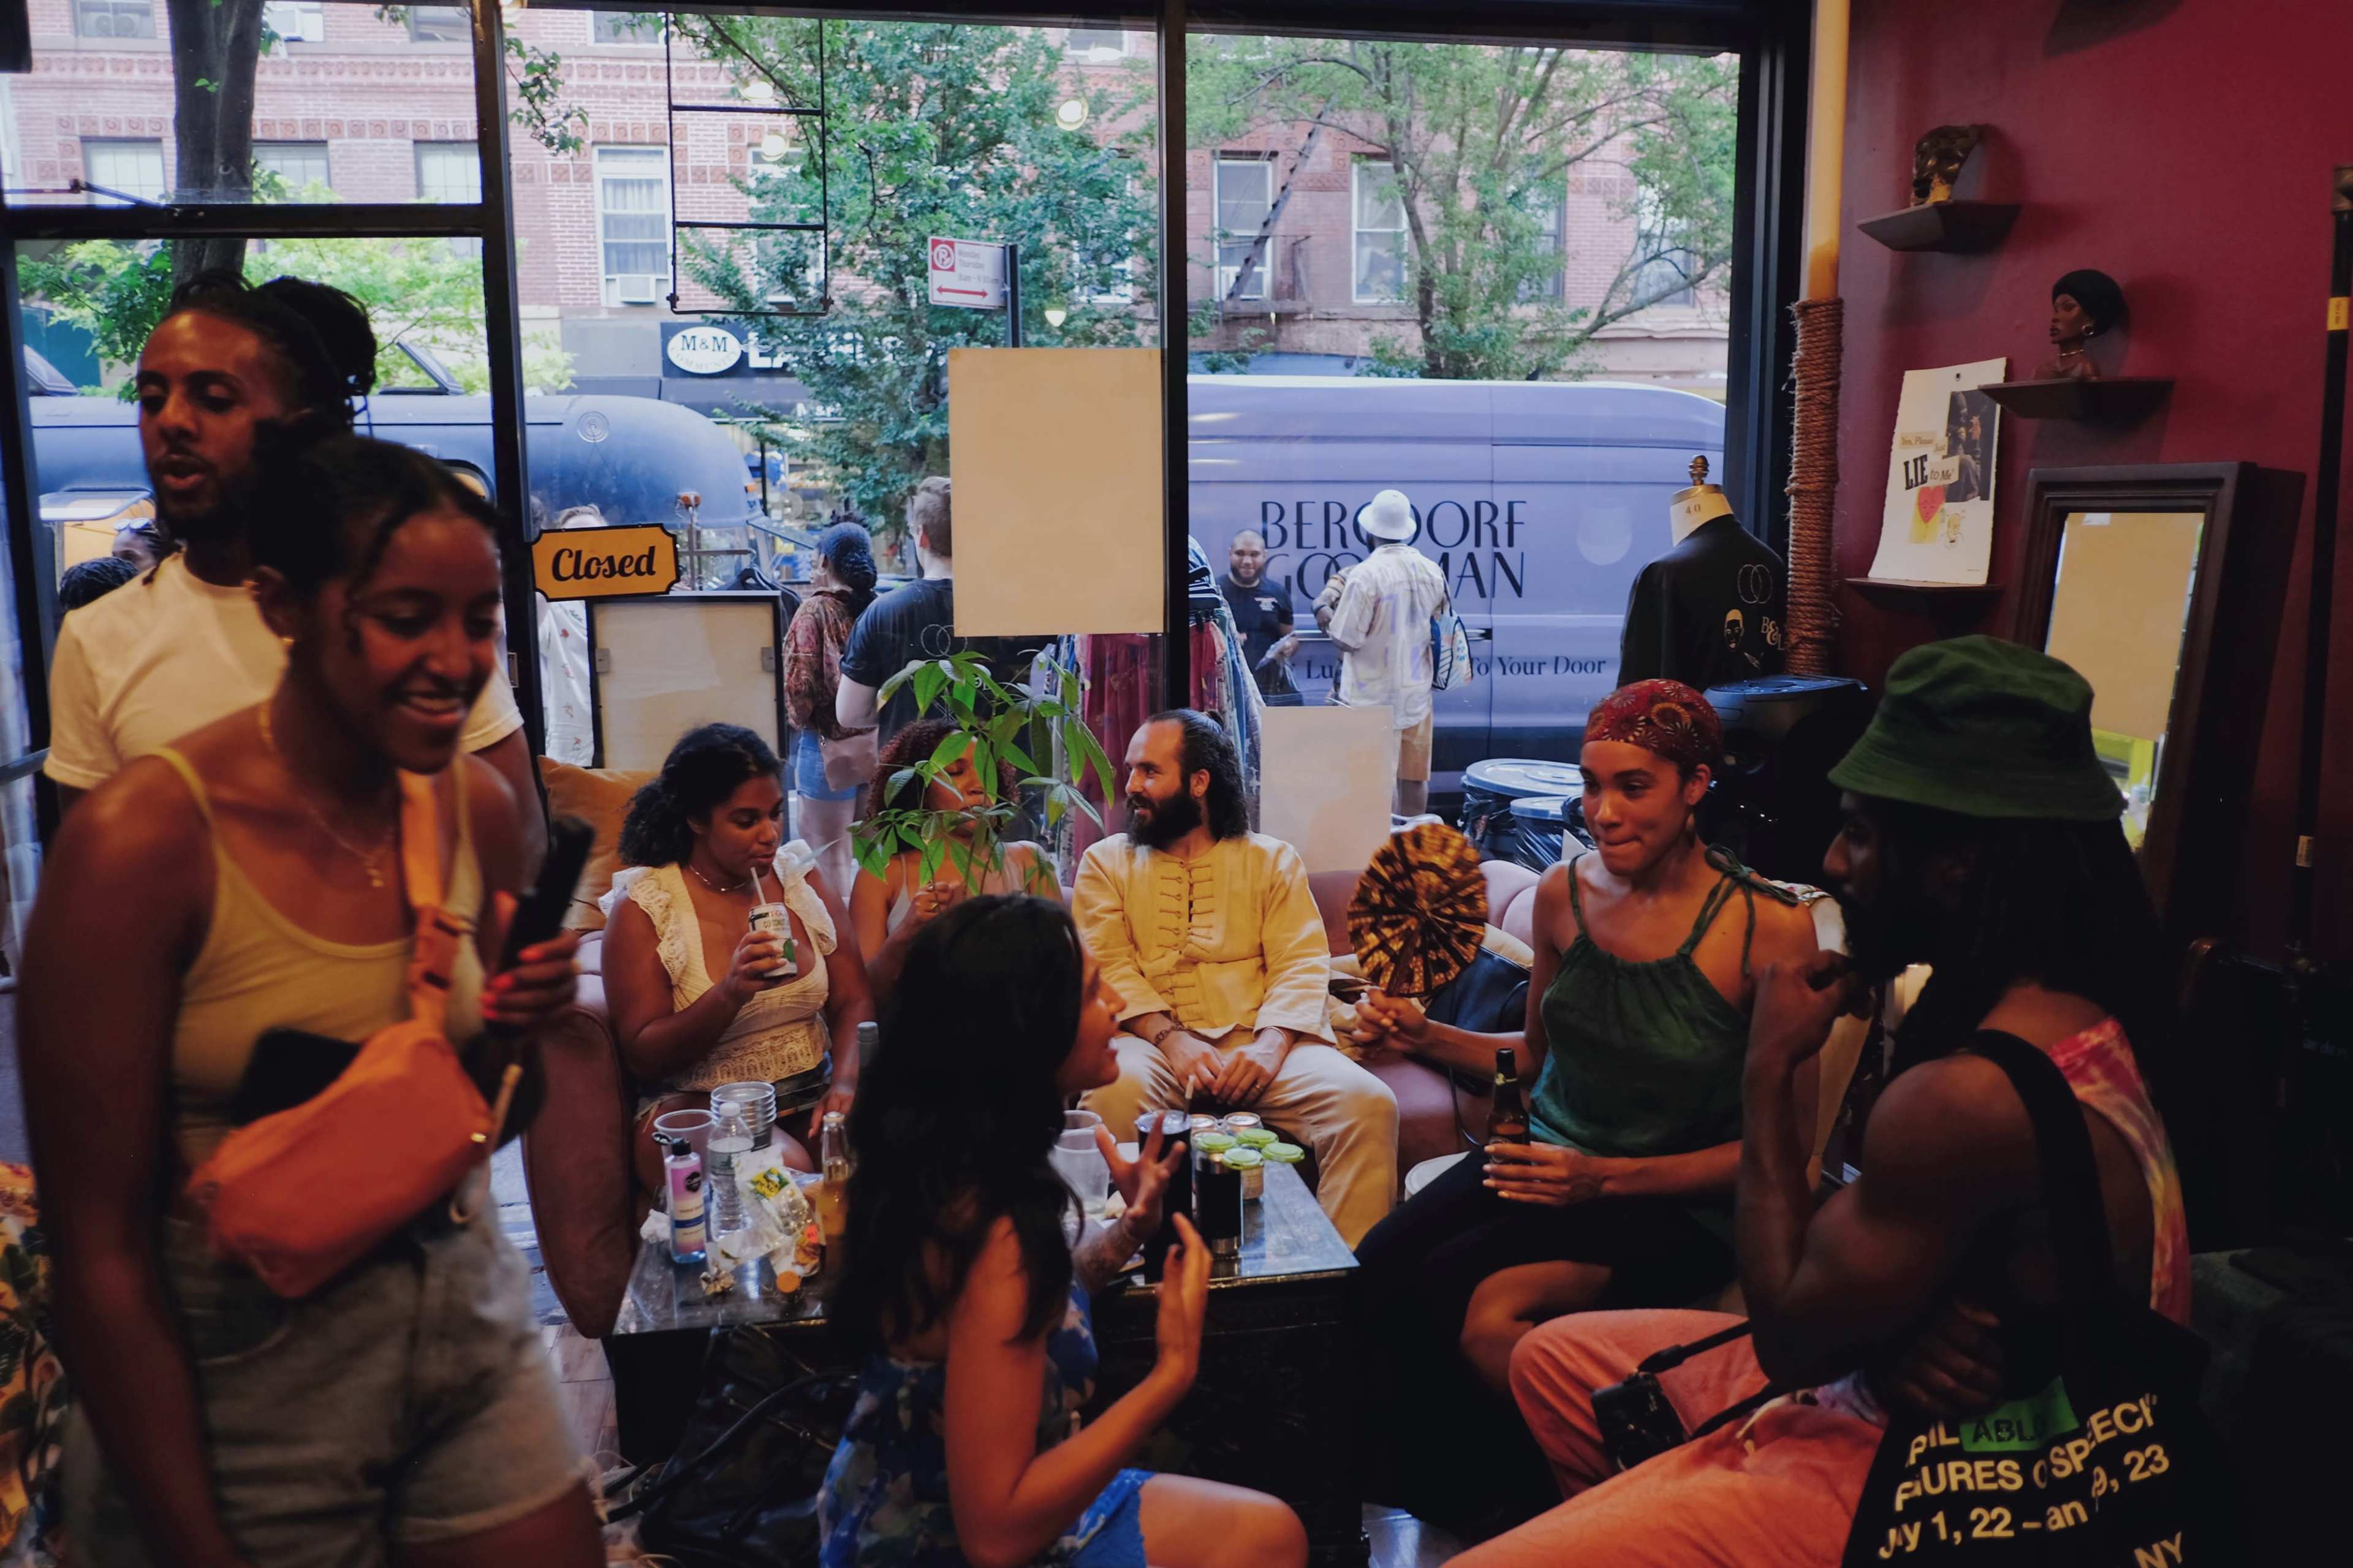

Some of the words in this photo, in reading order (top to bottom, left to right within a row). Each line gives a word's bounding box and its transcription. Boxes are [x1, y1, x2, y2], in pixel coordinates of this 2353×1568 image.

[1903, 454, 1928, 490] LIE
[1262, 501, 1527, 549] BERORF
[551, 545, 656, 582] Closed
[1498, 656, 1547, 676] Your
[1554, 656, 1606, 674] Door
[1931, 1510, 1963, 1545] 1,
